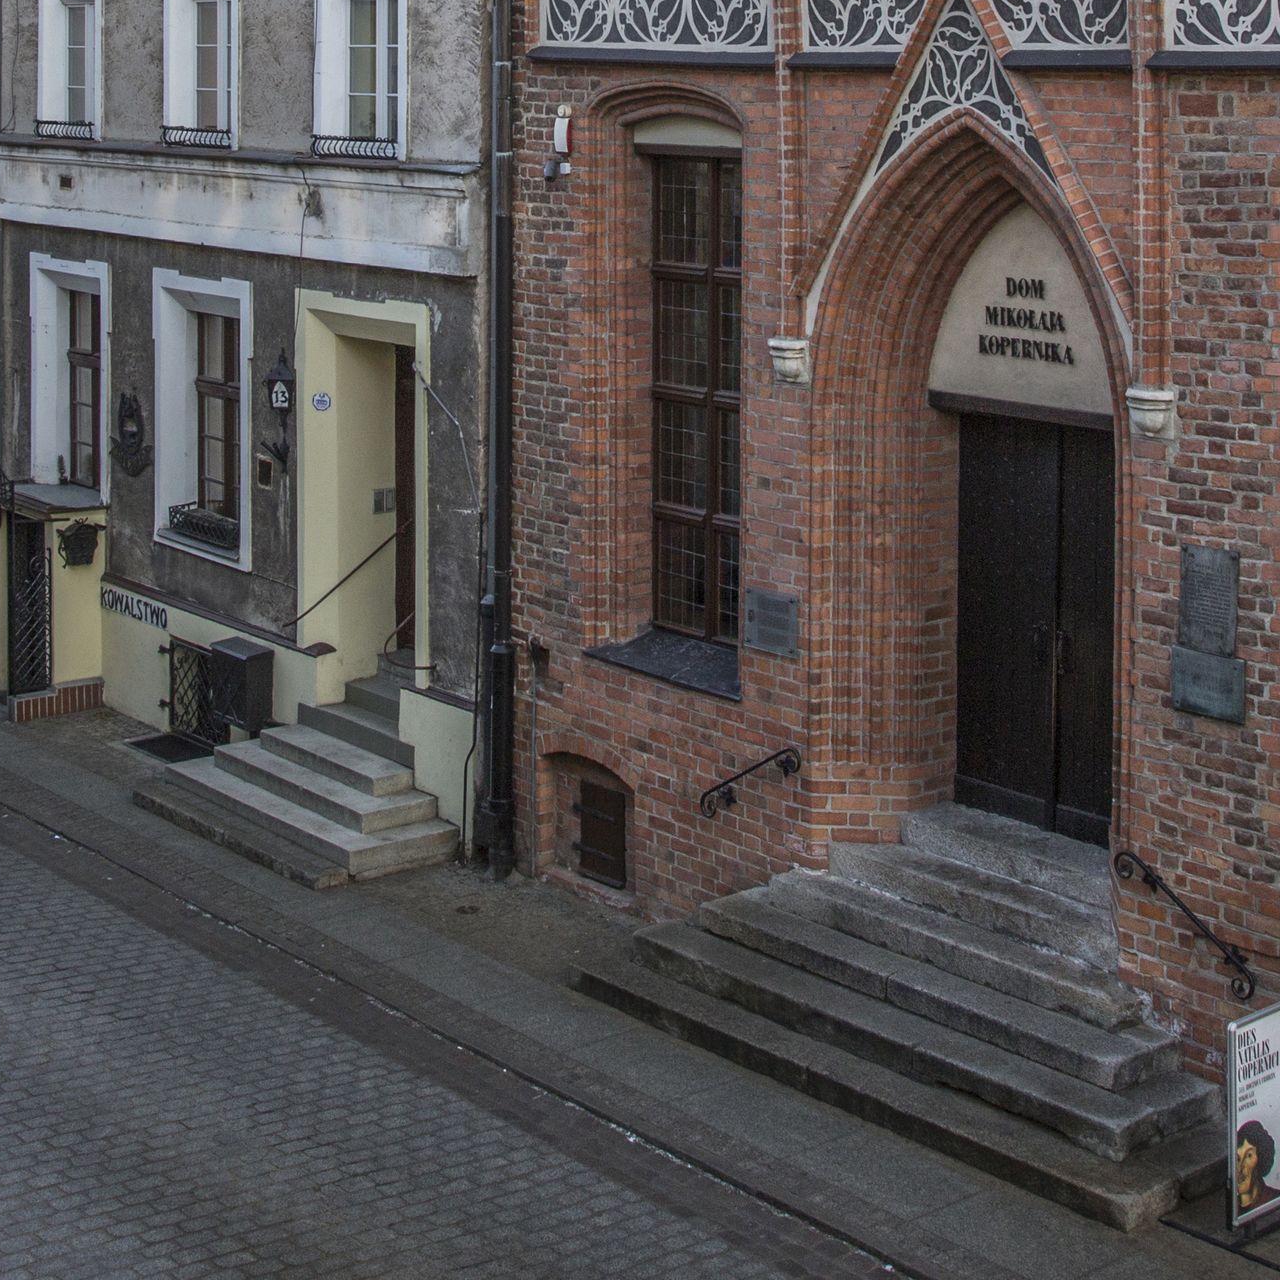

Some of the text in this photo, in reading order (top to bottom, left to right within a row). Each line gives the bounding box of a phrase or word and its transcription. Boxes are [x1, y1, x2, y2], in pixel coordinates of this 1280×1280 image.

[1006, 277, 1045, 300] DOM
[985, 306, 1066, 333] MIKOŁAJA
[979, 334, 1074, 365] KOPERNIKA
[273, 390, 288, 404] 13
[101, 587, 168, 629] KOWALSTWO
[1237, 1027, 1257, 1049] DIES
[1237, 1038, 1270, 1066] NATALIS
[1237, 1050, 1279, 1083] COPERNICI
